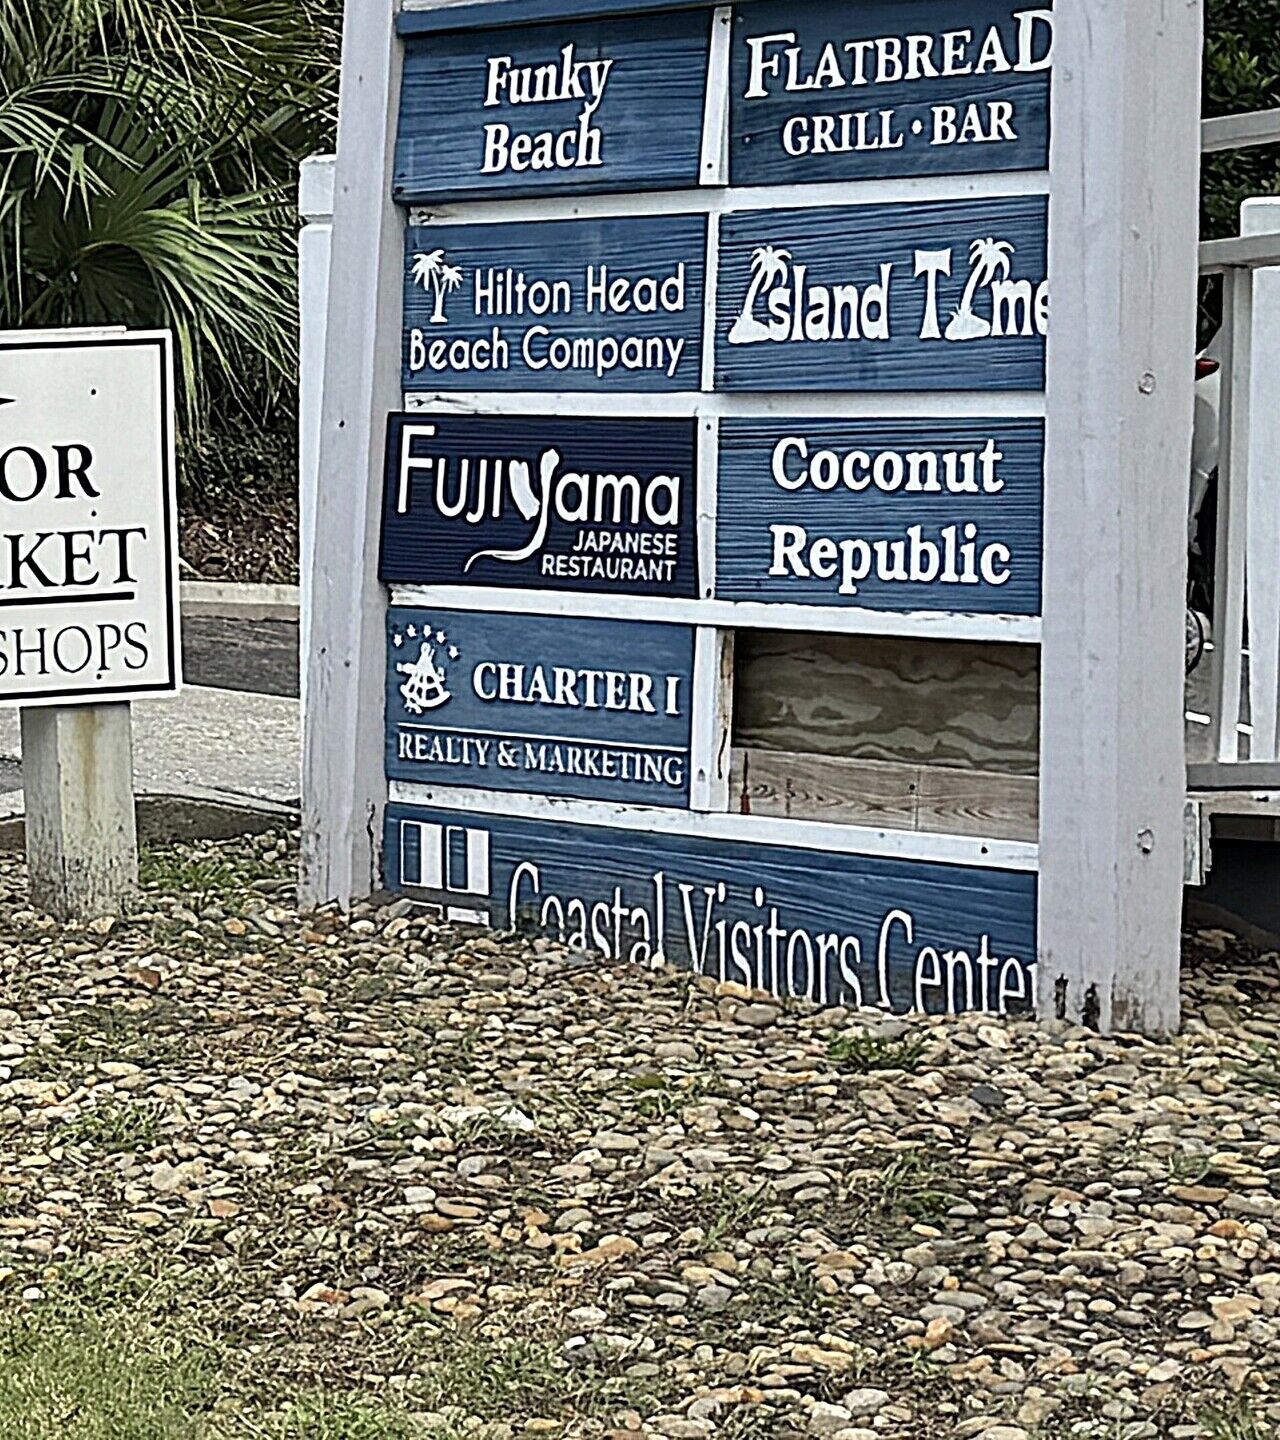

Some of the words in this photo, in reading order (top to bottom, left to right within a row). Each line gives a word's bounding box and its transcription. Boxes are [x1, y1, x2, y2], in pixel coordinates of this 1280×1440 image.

[483, 43, 614, 113] Funky
[743, 10, 1053, 99] FLATBREAD
[480, 113, 605, 174] Beach
[474, 267, 572, 315] Hilton
[586, 262, 686, 313] Head
[409, 328, 509, 371] Beach
[522, 325, 685, 377] Company
[771, 436, 1004, 494] Coconut
[541, 554, 678, 582] RESTAURANT
[572, 530, 679, 556] JAPANESE
[768, 523, 1012, 594] Republic
[473, 662, 656, 713] CHARTER
[665, 676, 681, 715] I
[397, 732, 491, 766] REALTY
[496, 740, 518, 767] &
[524, 742, 684, 785] MARKETING
[678, 881, 861, 1009] Visitors
